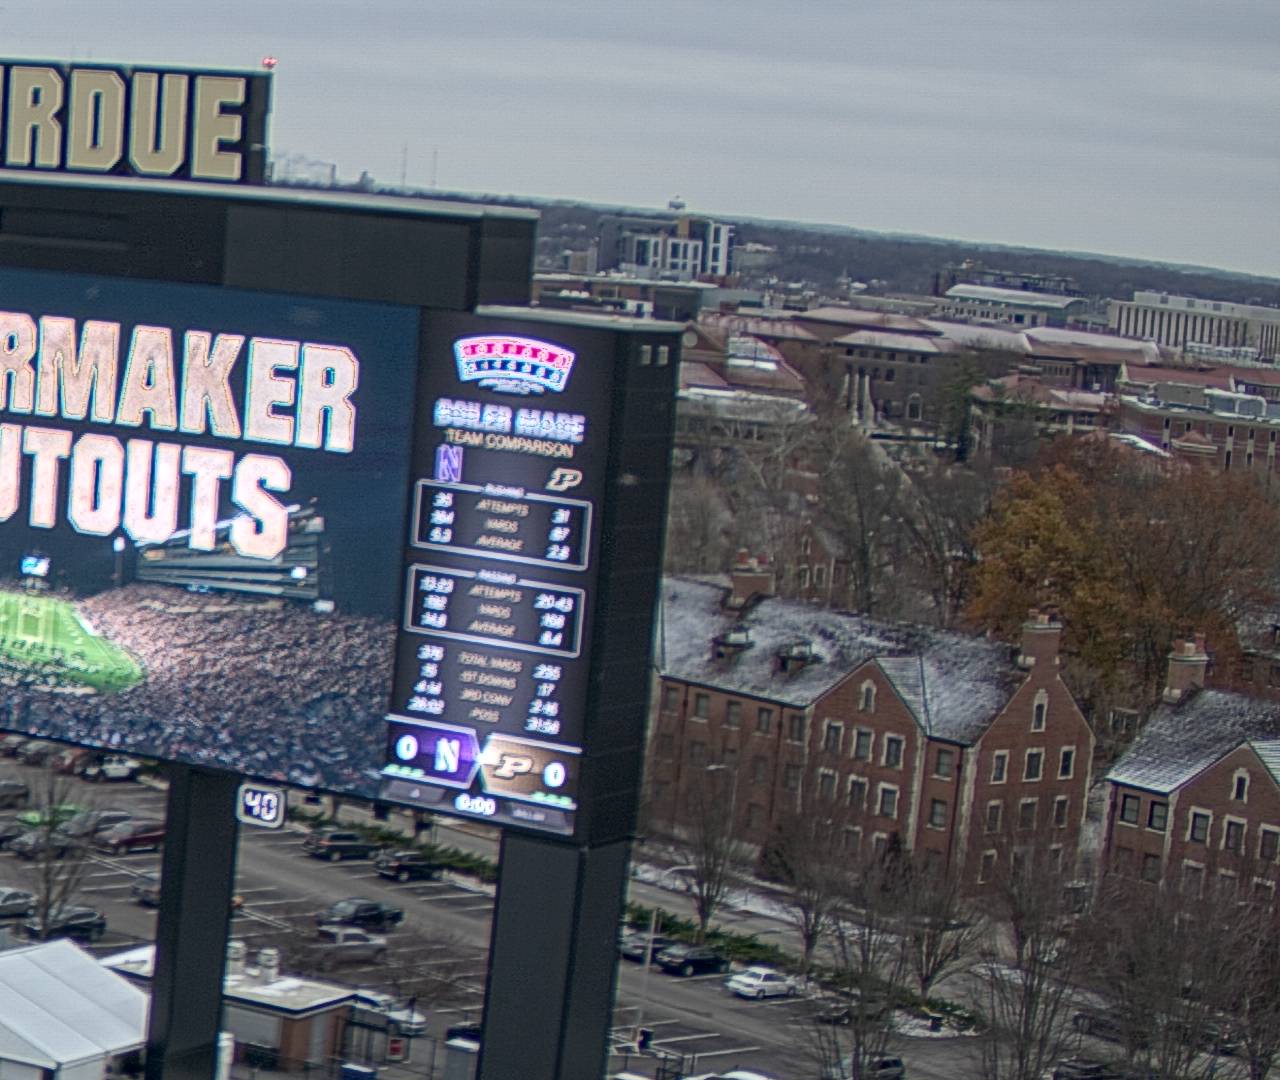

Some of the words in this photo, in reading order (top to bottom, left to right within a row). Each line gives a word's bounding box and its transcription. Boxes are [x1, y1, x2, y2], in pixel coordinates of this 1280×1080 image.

[445, 429, 483, 446] TEAM
[486, 433, 574, 459] COMPARISON
[434, 737, 460, 773] N
[494, 754, 533, 780] P
[244, 791, 278, 821] 40
